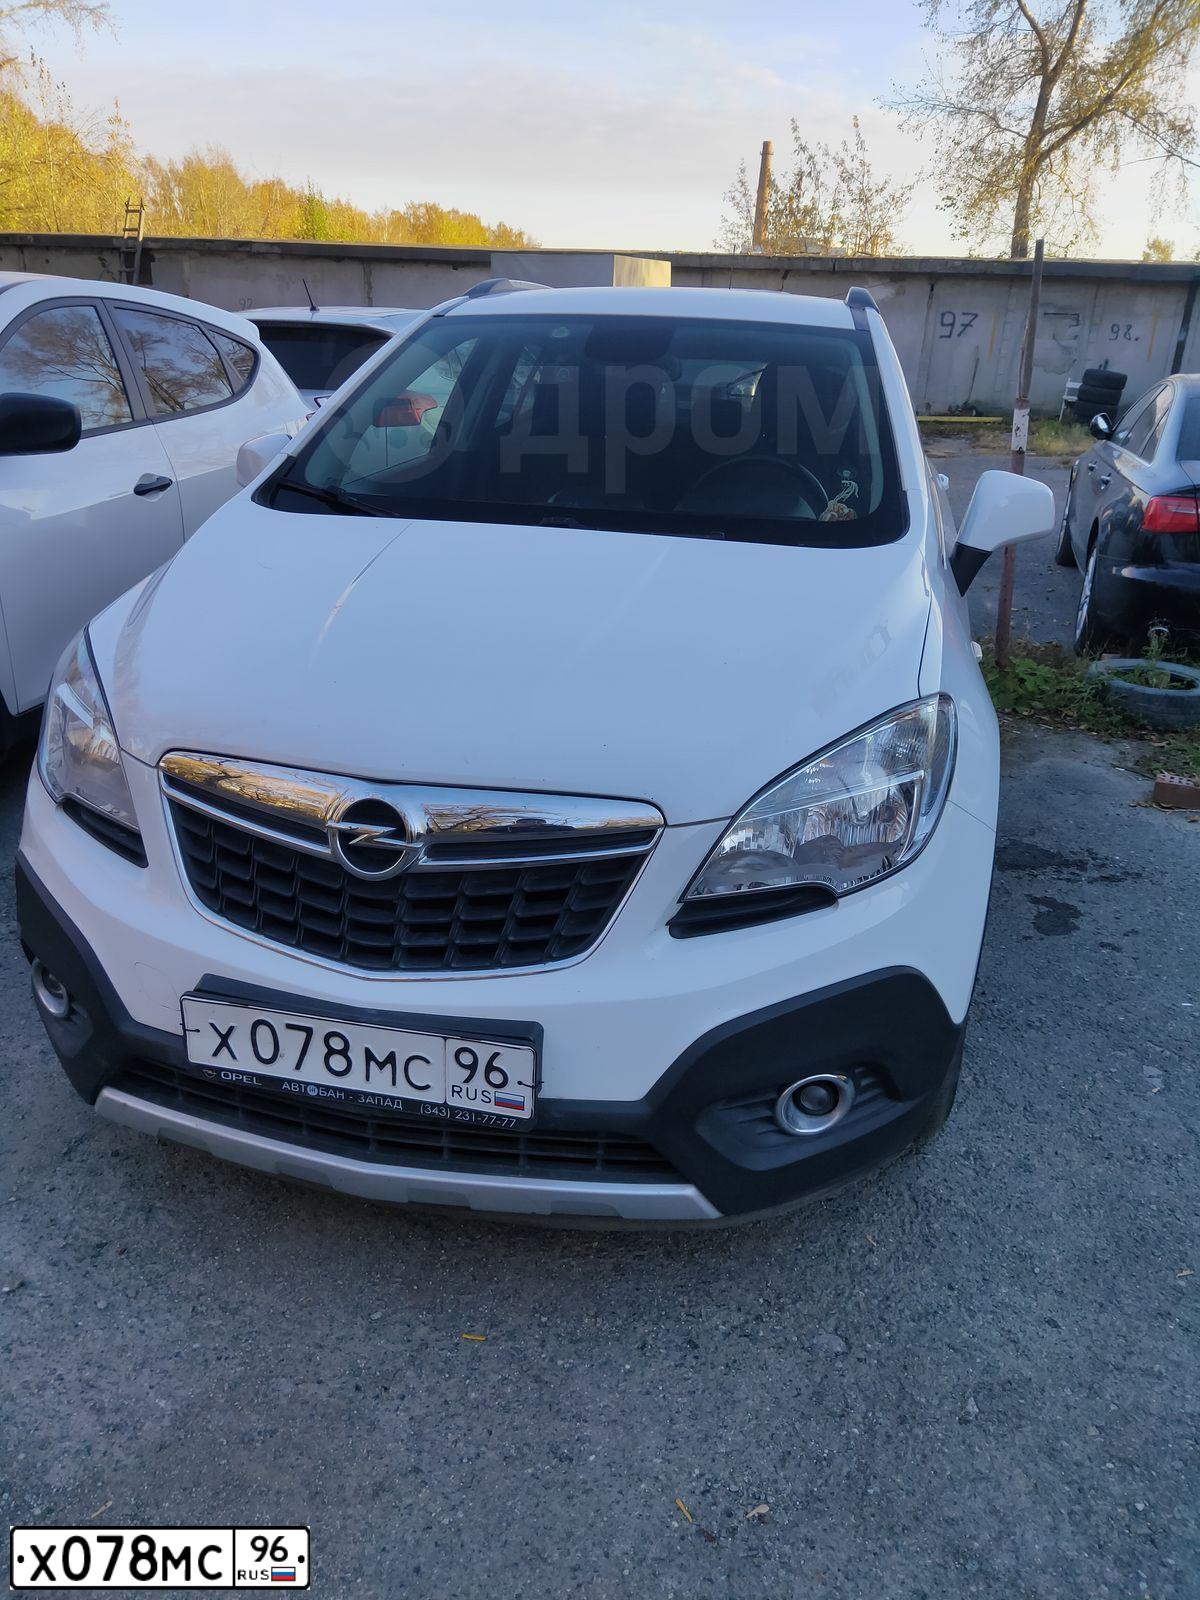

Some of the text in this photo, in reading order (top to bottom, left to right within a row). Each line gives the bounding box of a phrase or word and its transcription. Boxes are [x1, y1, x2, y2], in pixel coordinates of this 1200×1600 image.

[939, 311, 978, 339] 97
[454, 1047, 509, 1089] 96
[220, 1071, 263, 1087] OPEL
[358, 1093, 403, 1111] ЗАПАД
[451, 1085, 492, 1103] RUS
[420, 1104, 517, 1128] (343) 231-77-77
